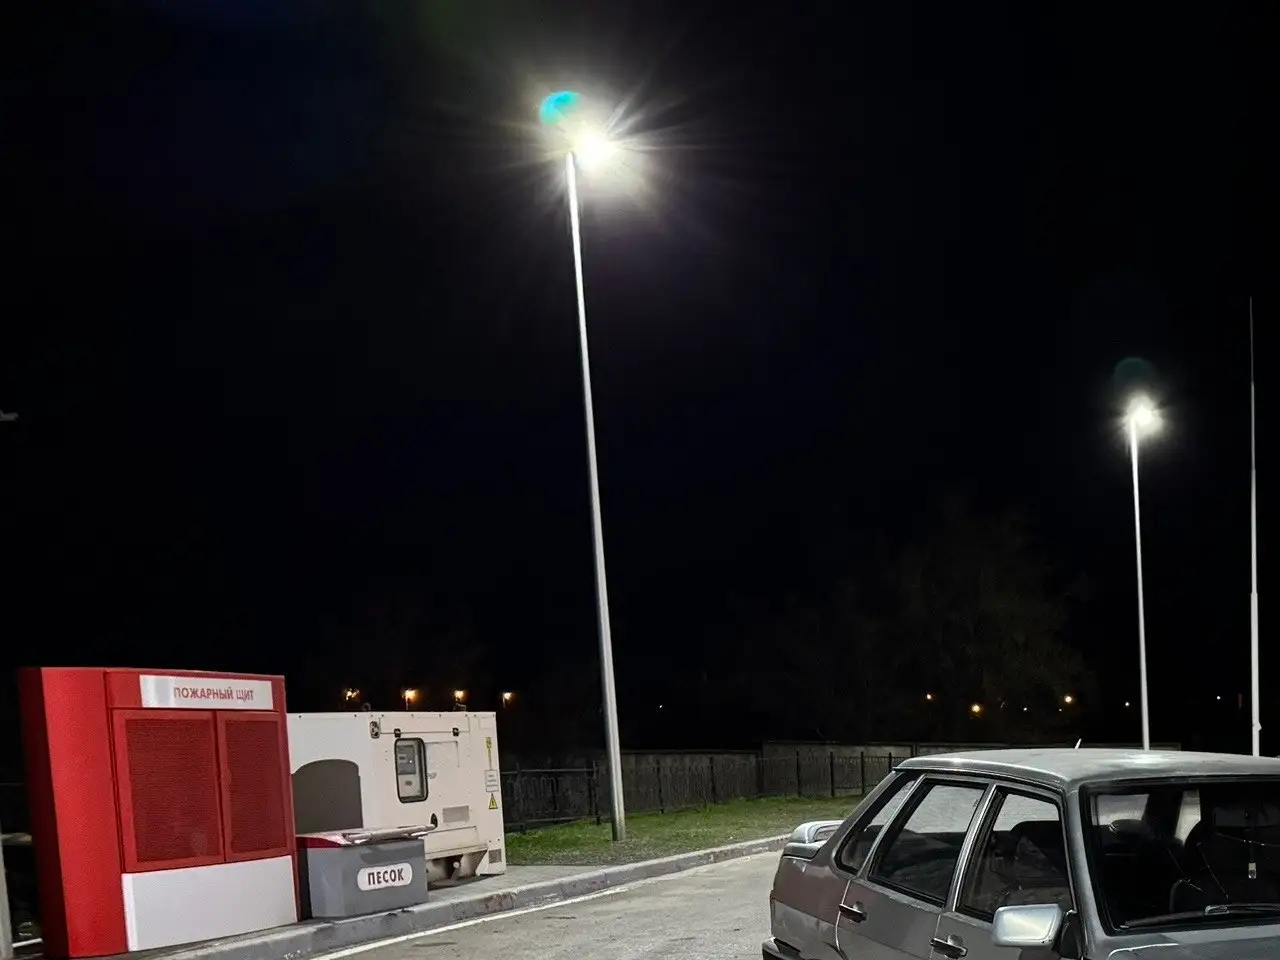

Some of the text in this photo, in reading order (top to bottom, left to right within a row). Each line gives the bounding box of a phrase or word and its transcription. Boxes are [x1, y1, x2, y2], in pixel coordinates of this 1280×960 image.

[173, 686, 255, 702] ПОЖАРНЫЙ ЩИТ
[367, 867, 404, 886] ПЕСОК
